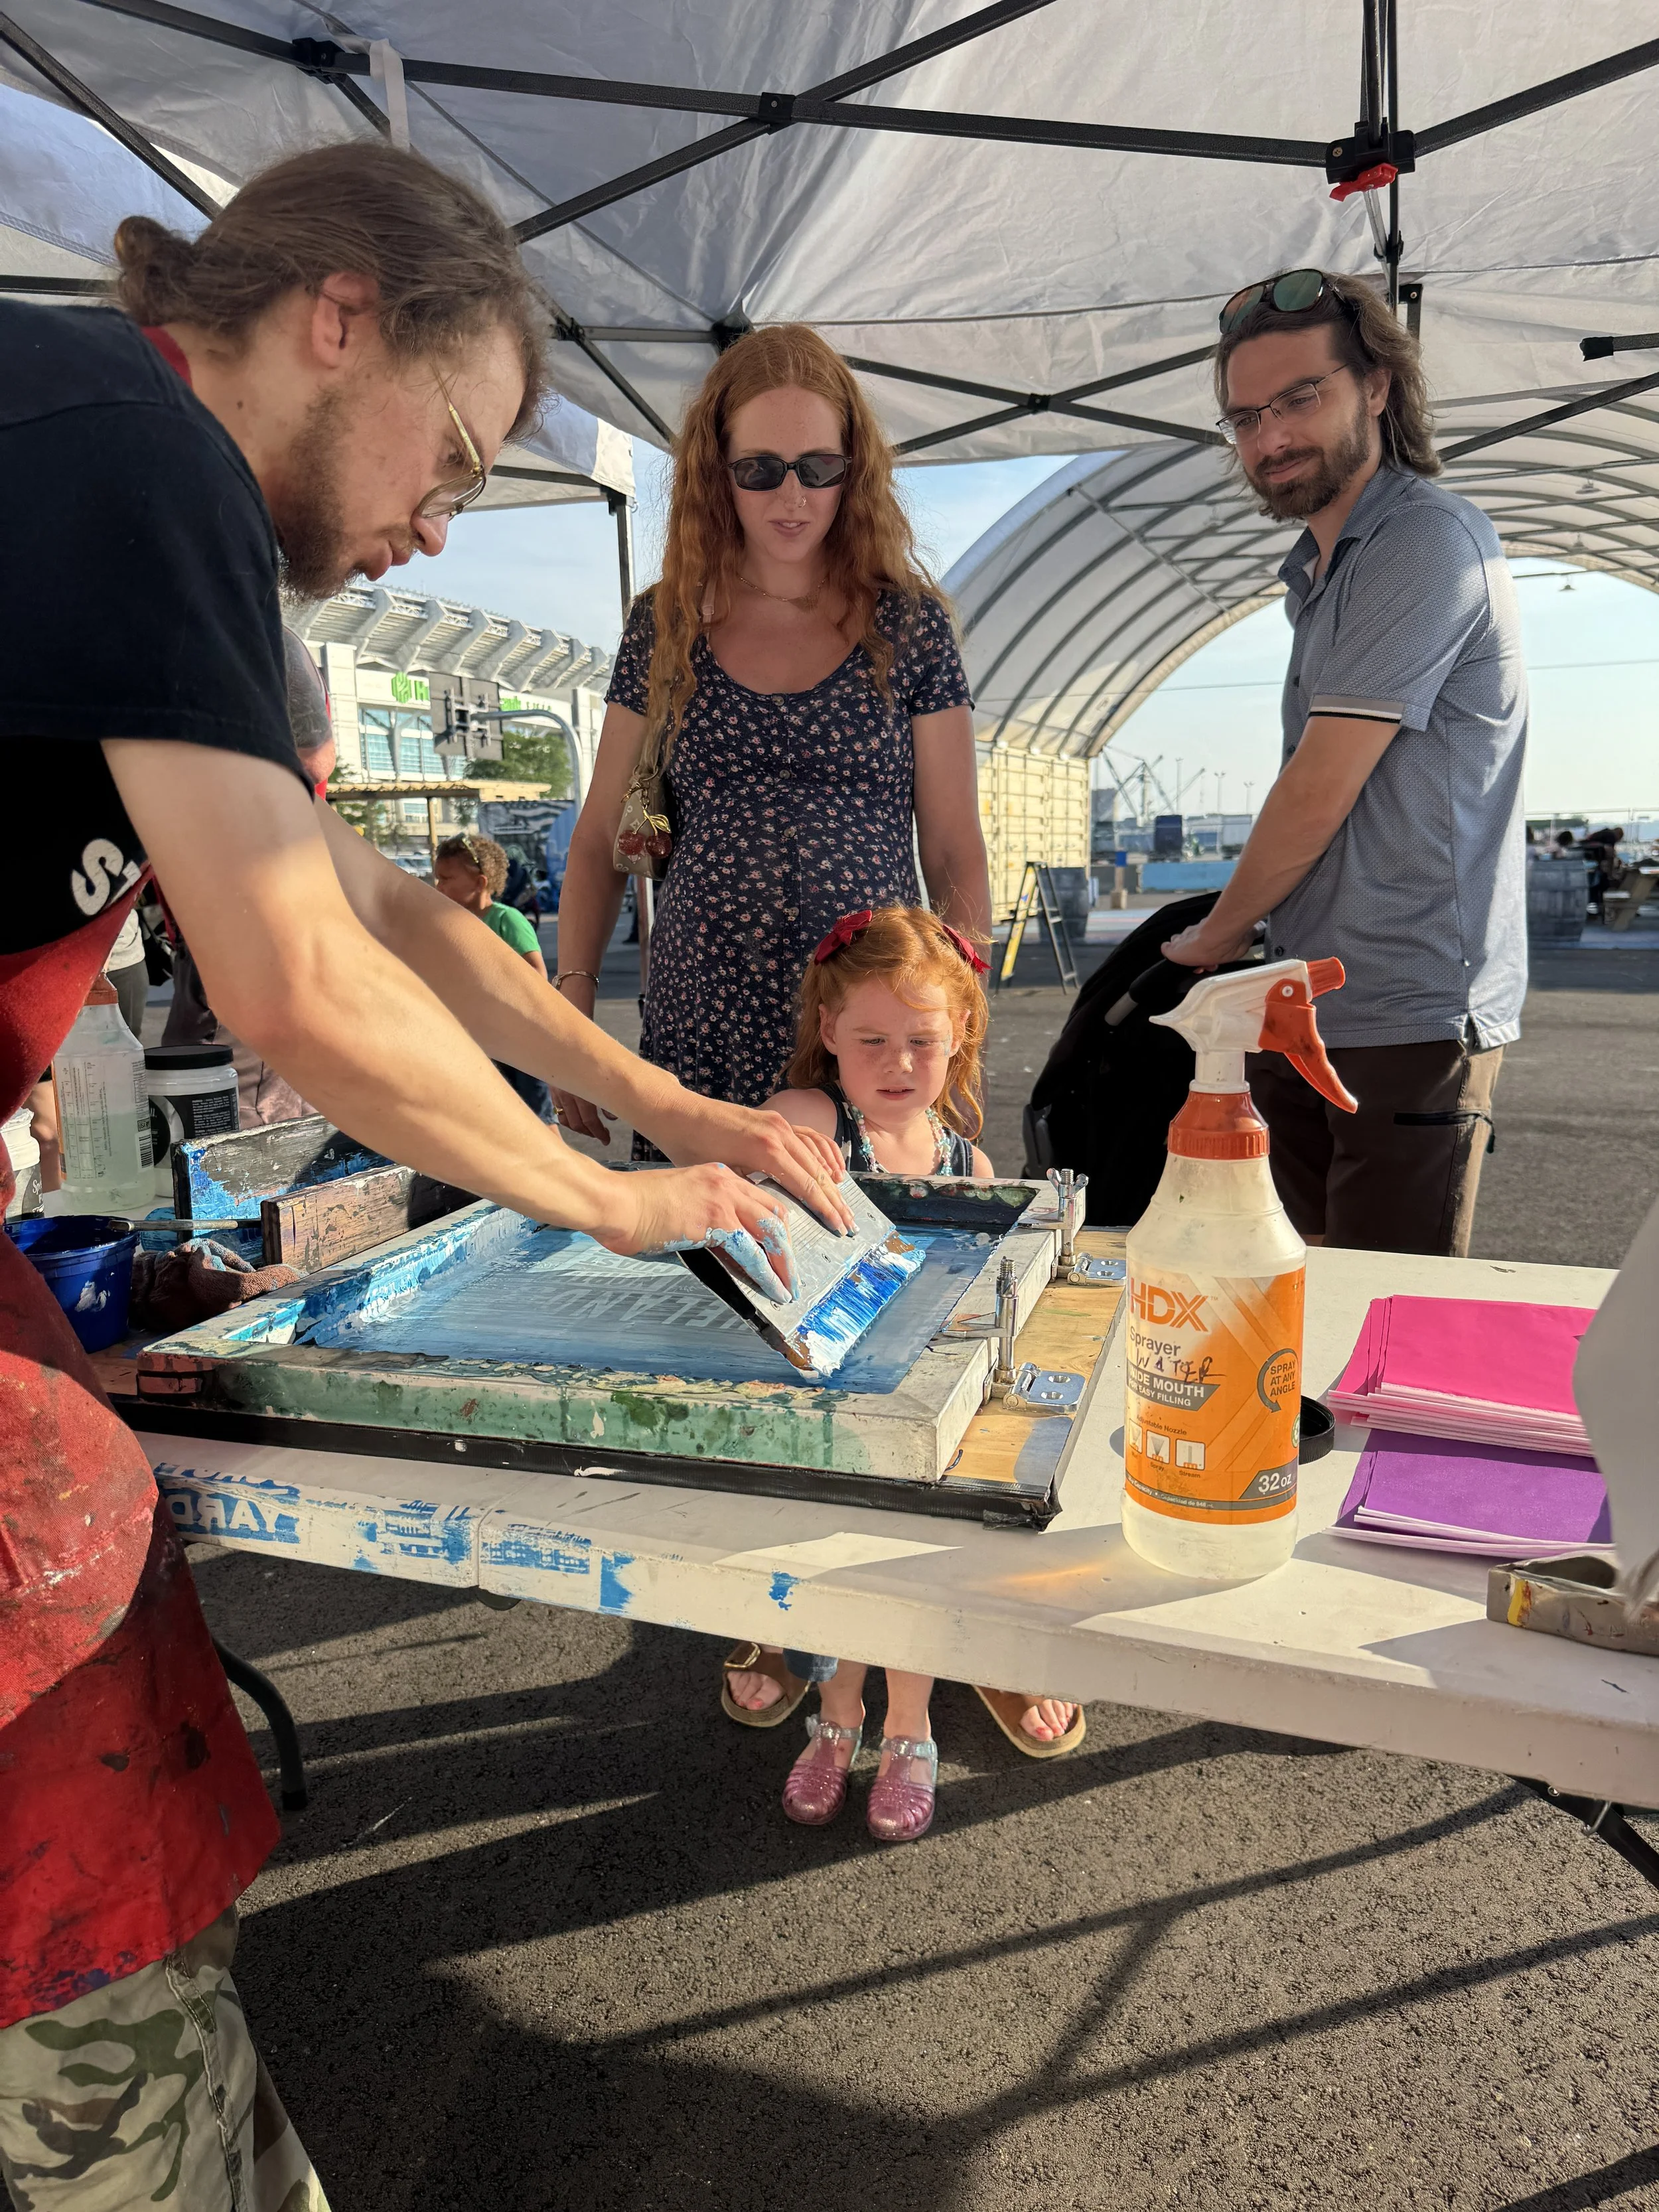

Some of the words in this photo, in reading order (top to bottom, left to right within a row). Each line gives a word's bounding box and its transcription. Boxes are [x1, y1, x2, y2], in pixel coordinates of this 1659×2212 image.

[1130, 1278, 1208, 1332] HDX
[1130, 1326, 1181, 1356] Sprayer
[1270, 1359, 1295, 1374] SPRAY
[1129, 1364, 1150, 1386] WIDE
[1153, 1378, 1204, 1398] MOUTH
[1270, 1375, 1281, 1386] AT
[1282, 1370, 1295, 1384] ANY
[1129, 1378, 1137, 1391] FOR
[1139, 1386, 1155, 1398] EASY
[1157, 1392, 1190, 1406] FILLING
[1270, 1381, 1295, 1397] ANGLE
[1137, 1414, 1163, 1430] Adjustable
[1164, 1426, 1187, 1435] Nozzle
[1150, 1462, 1164, 1472] Spray
[1134, 1481, 1152, 1496] Capacity
[1258, 1473, 1280, 1493] 32
[1281, 1473, 1292, 1487] oz
